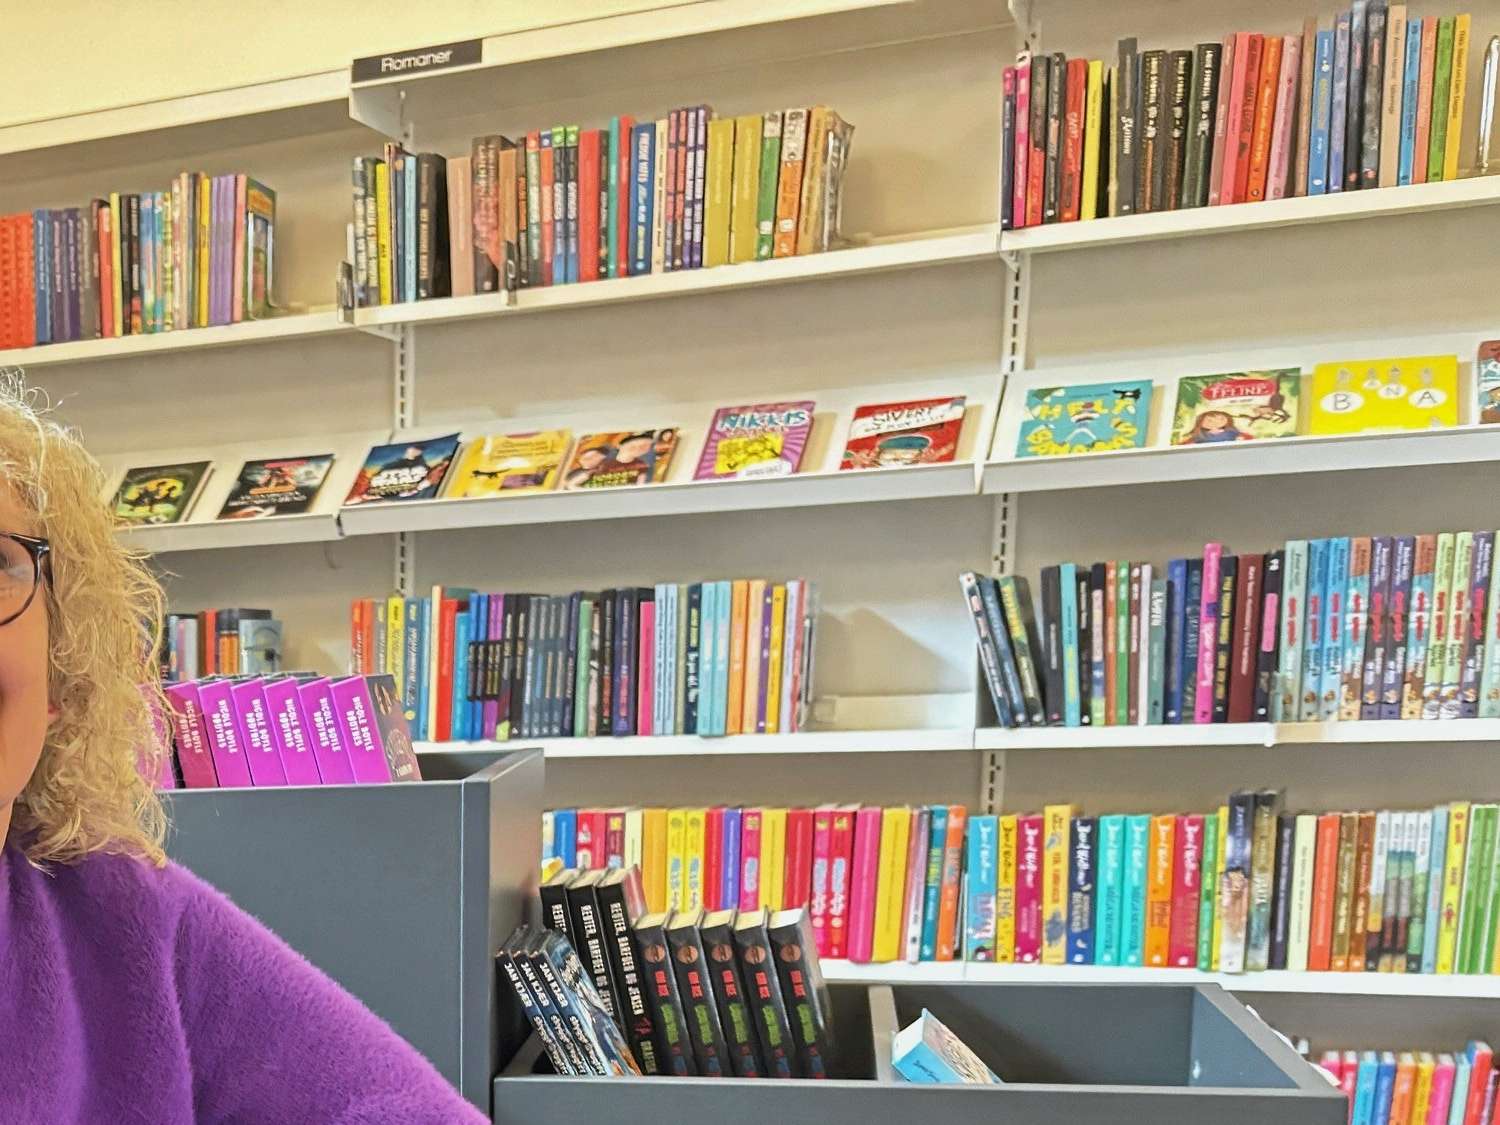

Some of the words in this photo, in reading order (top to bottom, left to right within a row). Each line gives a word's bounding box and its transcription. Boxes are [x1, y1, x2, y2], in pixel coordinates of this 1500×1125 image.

[381, 48, 451, 73] Romaner
[218, 699, 231, 726] NICOLE
[252, 698, 266, 726] NICOLE
[285, 698, 300, 726] NICOLE
[319, 698, 334, 727] NICOLE
[352, 696, 367, 725] NICOLE
[191, 730, 205, 754] BOYLE
[224, 729, 238, 753] BOYLE
[258, 728, 272, 752] BOYLE
[291, 727, 306, 752] BOYLE
[326, 728, 341, 752] BOYLE
[359, 727, 374, 751] BOYLE
[504, 962, 519, 982] JAN
[520, 962, 536, 982] JAN
[538, 962, 555, 982] JAN
